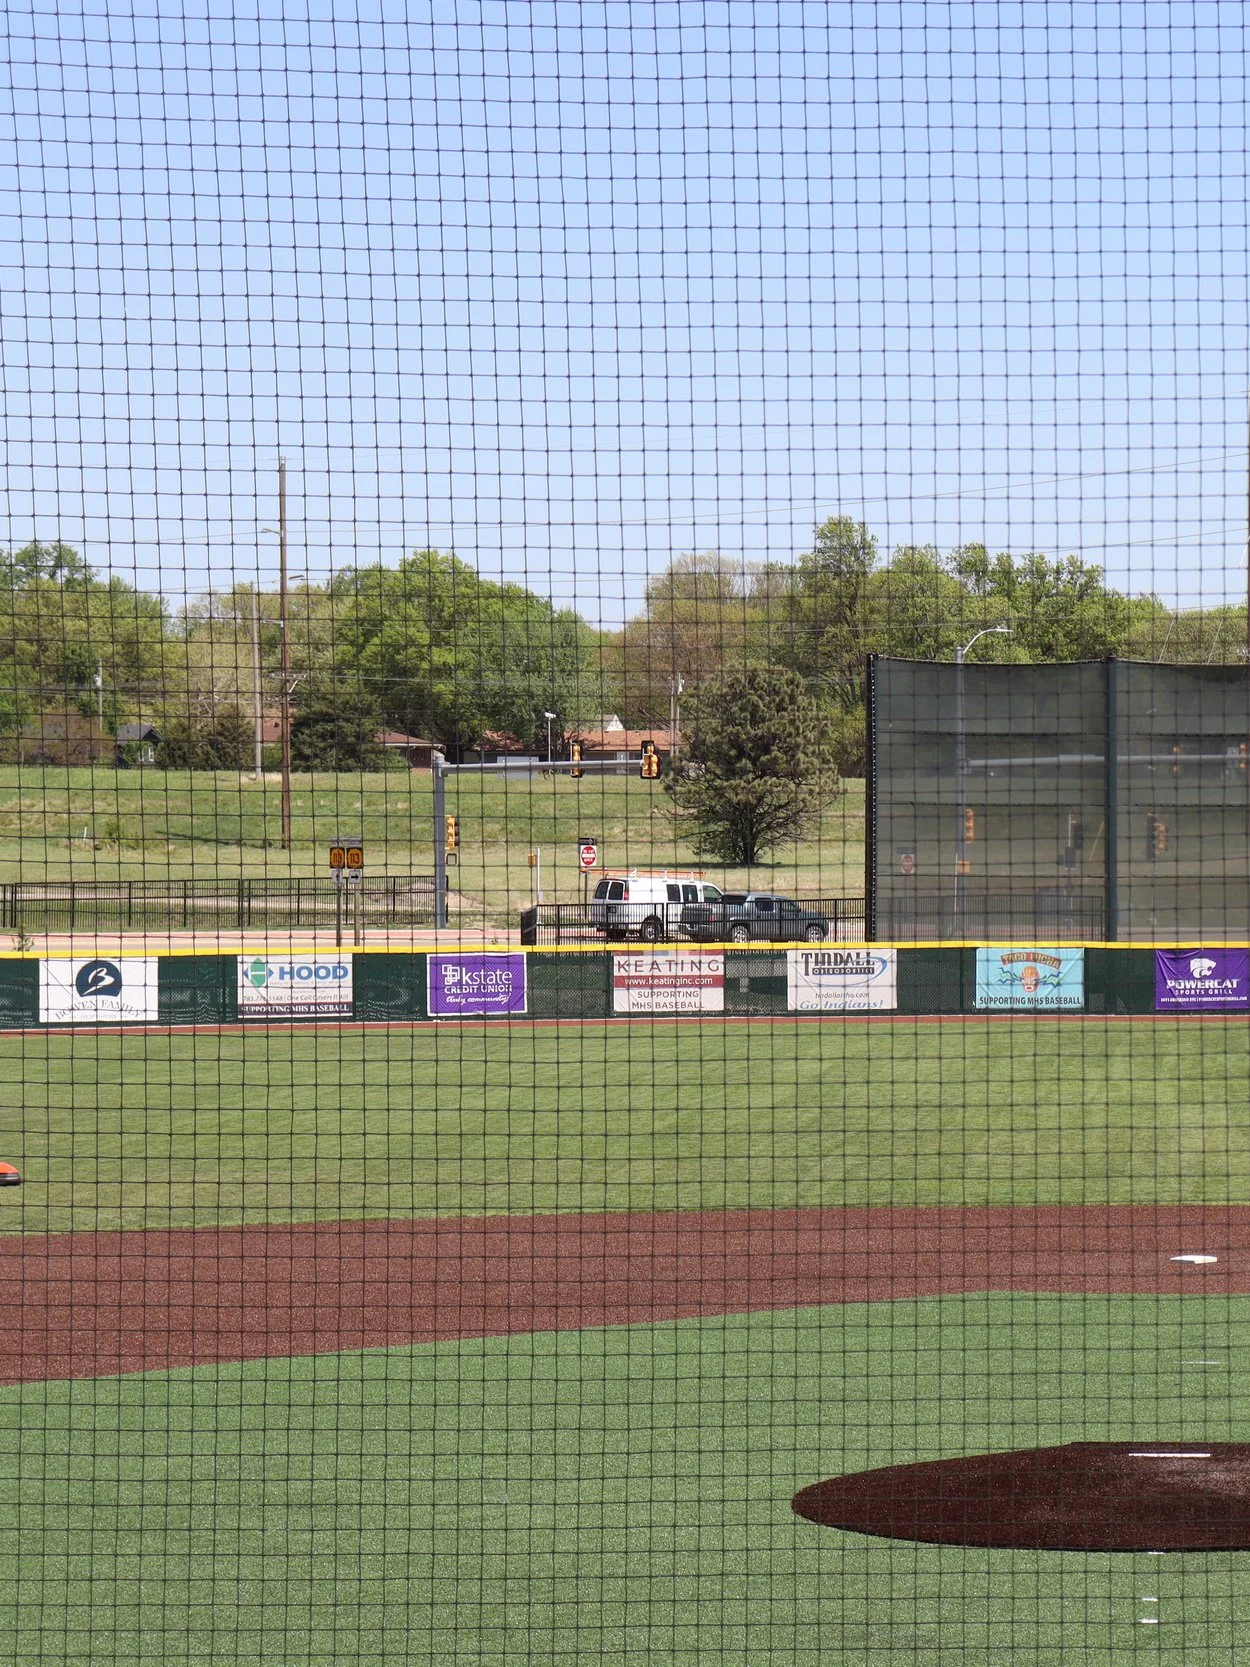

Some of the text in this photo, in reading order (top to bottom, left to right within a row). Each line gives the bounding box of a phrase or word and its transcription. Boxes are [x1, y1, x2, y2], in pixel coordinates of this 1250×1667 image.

[1003, 953, 1026, 964] TACO
[617, 959, 720, 972] KEATING
[801, 952, 875, 976] TINDALL
[278, 965, 348, 980] HOOD
[462, 967, 512, 984] kstate
[624, 977, 713, 986] www.keatinginc.com
[1167, 979, 1240, 989] POWERCAT
[444, 985, 512, 994] CREDIT UNION
[655, 1001, 705, 1009] BASEBALL
[800, 1000, 884, 1009] Go Indians!
[979, 996, 1081, 1005] SUPPORTING MHS BASEBALL
[309, 1004, 349, 1012] BASEBALL
